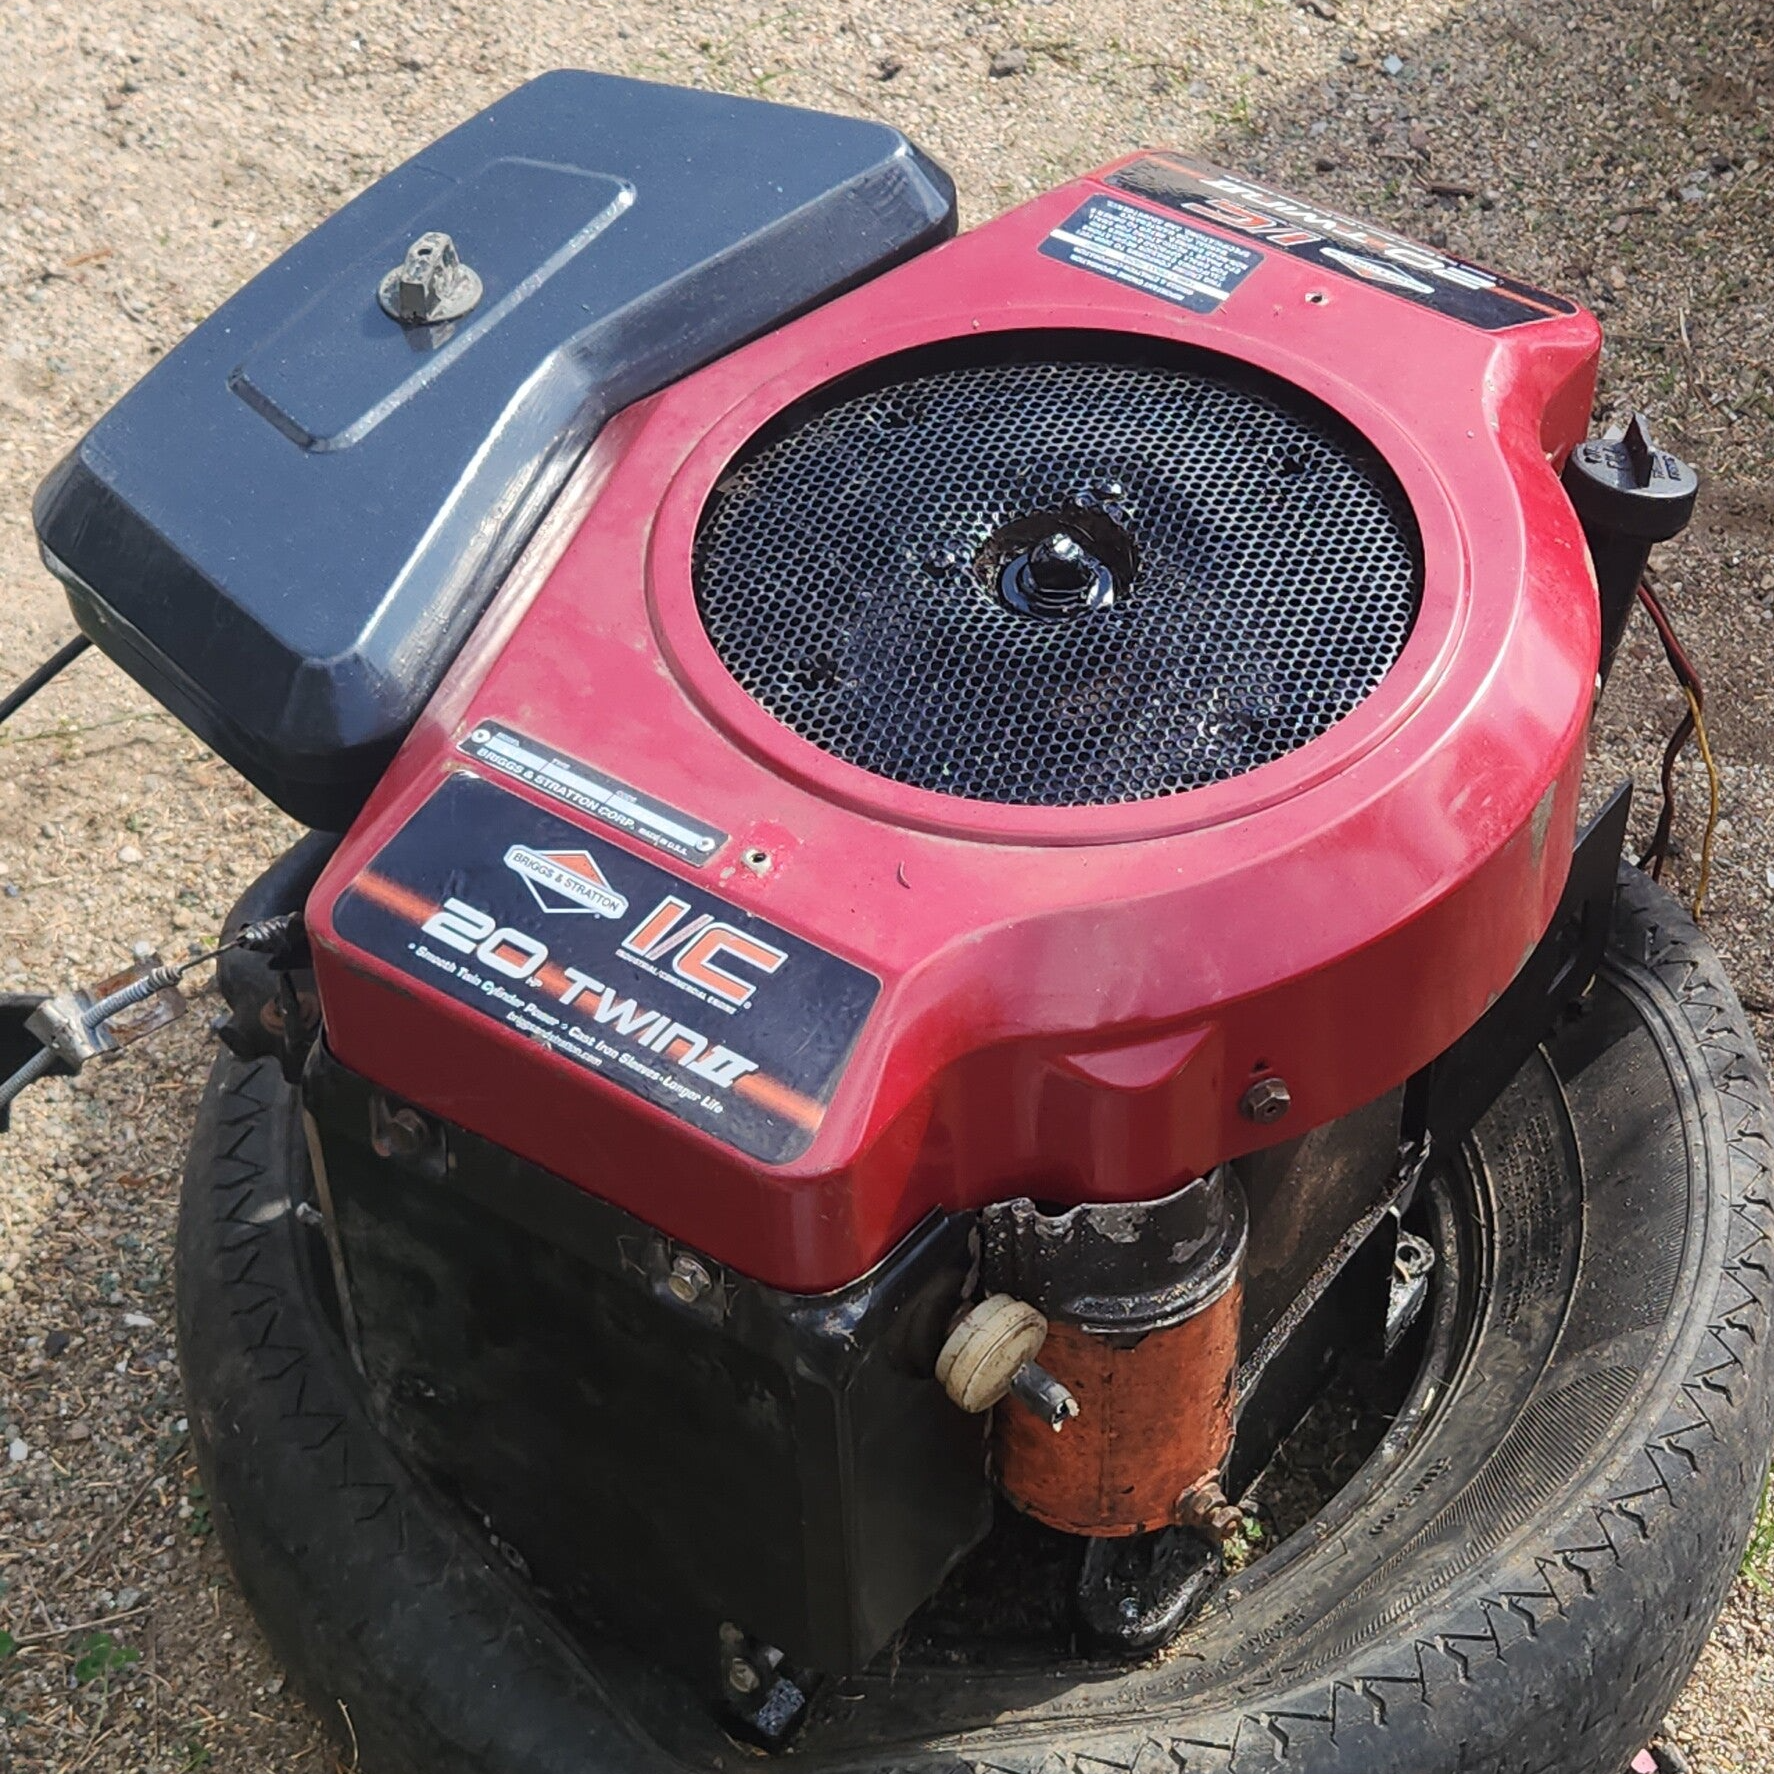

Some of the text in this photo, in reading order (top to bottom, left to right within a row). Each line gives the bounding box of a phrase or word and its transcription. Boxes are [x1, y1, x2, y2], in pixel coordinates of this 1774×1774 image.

[1384, 248, 1497, 290] 20
[476, 748, 635, 830] BRIGGS & STRATTON CORP.
[513, 852, 619, 911] BRIGGS & STRATTON
[421, 897, 548, 979] 20
[621, 894, 789, 1006] I/C
[415, 945, 457, 974] Smooth
[456, 966, 482, 986] Twin
[481, 980, 525, 1009] Cylinder
[524, 1002, 560, 1026] Power
[568, 1025, 596, 1046] Cast
[594, 1040, 620, 1060] Iron
[618, 1053, 661, 1081] Sleeves
[700, 1096, 724, 1114] Life
